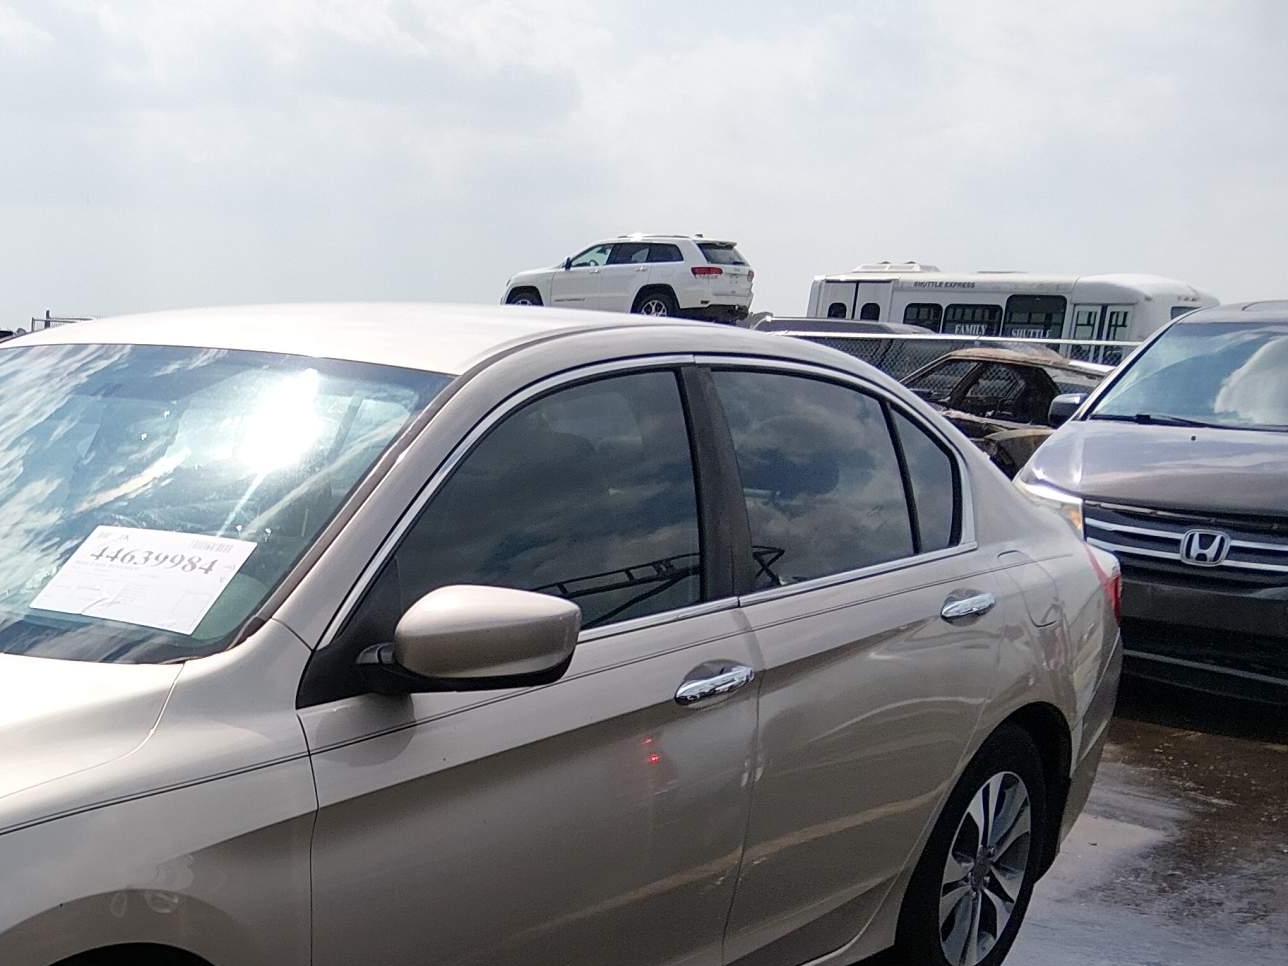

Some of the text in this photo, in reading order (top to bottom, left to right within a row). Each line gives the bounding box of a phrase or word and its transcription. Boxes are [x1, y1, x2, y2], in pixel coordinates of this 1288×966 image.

[913, 281, 975, 289] SHUTTLE EXPRESS
[954, 323, 987, 336] FAMILY
[89, 545, 219, 575] 44639984
